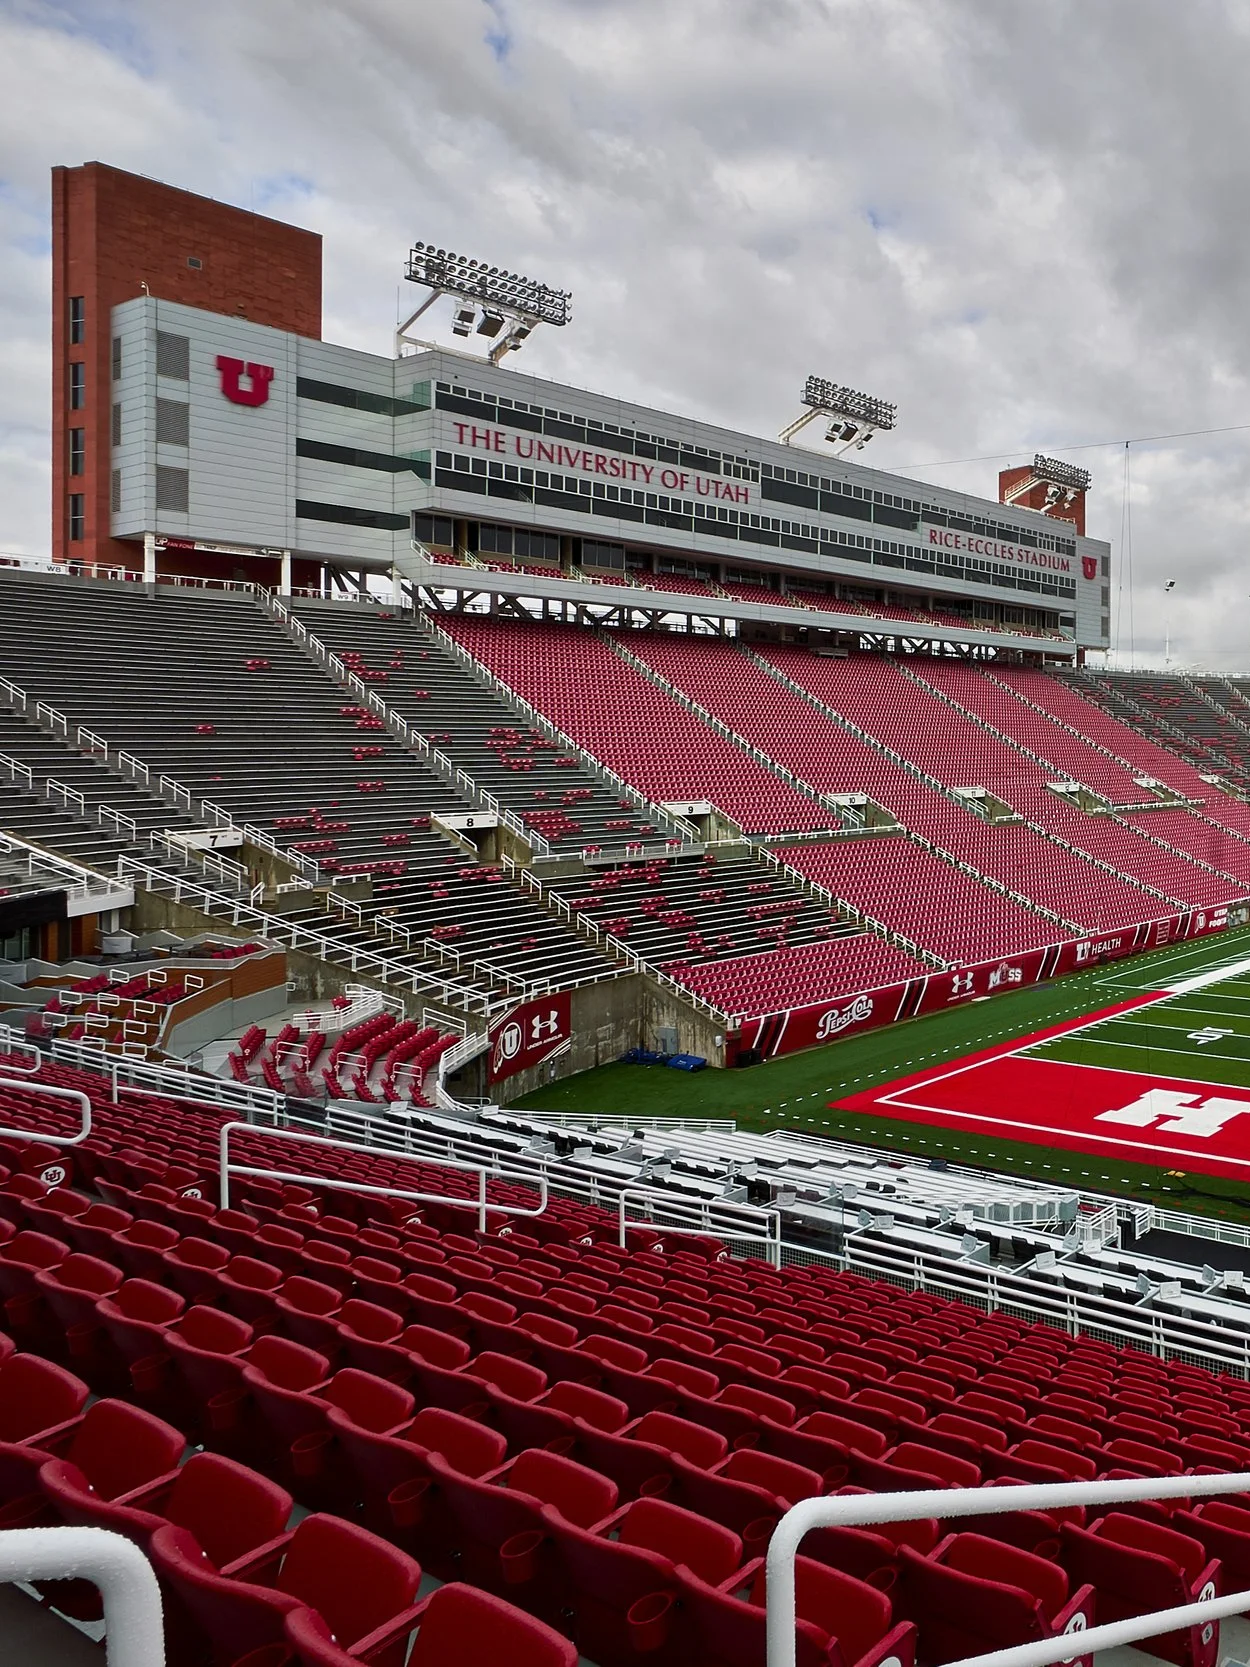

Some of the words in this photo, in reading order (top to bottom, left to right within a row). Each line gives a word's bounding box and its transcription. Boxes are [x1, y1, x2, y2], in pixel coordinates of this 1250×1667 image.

[216, 354, 274, 407] U
[453, 422, 506, 453] THE
[515, 436, 654, 484] UNIVERSITY
[661, 469, 690, 492] OF
[695, 476, 750, 505] UTAH
[929, 528, 1014, 561] RICE-ECCLES
[1017, 549, 1070, 573] STADIUM
[46, 565, 61, 573] W8
[1082, 556, 1097, 580] U
[687, 806, 694, 814] 9
[466, 818, 474, 827] 8
[209, 835, 218, 847] 7
[1092, 937, 1122, 956] HEALTH
